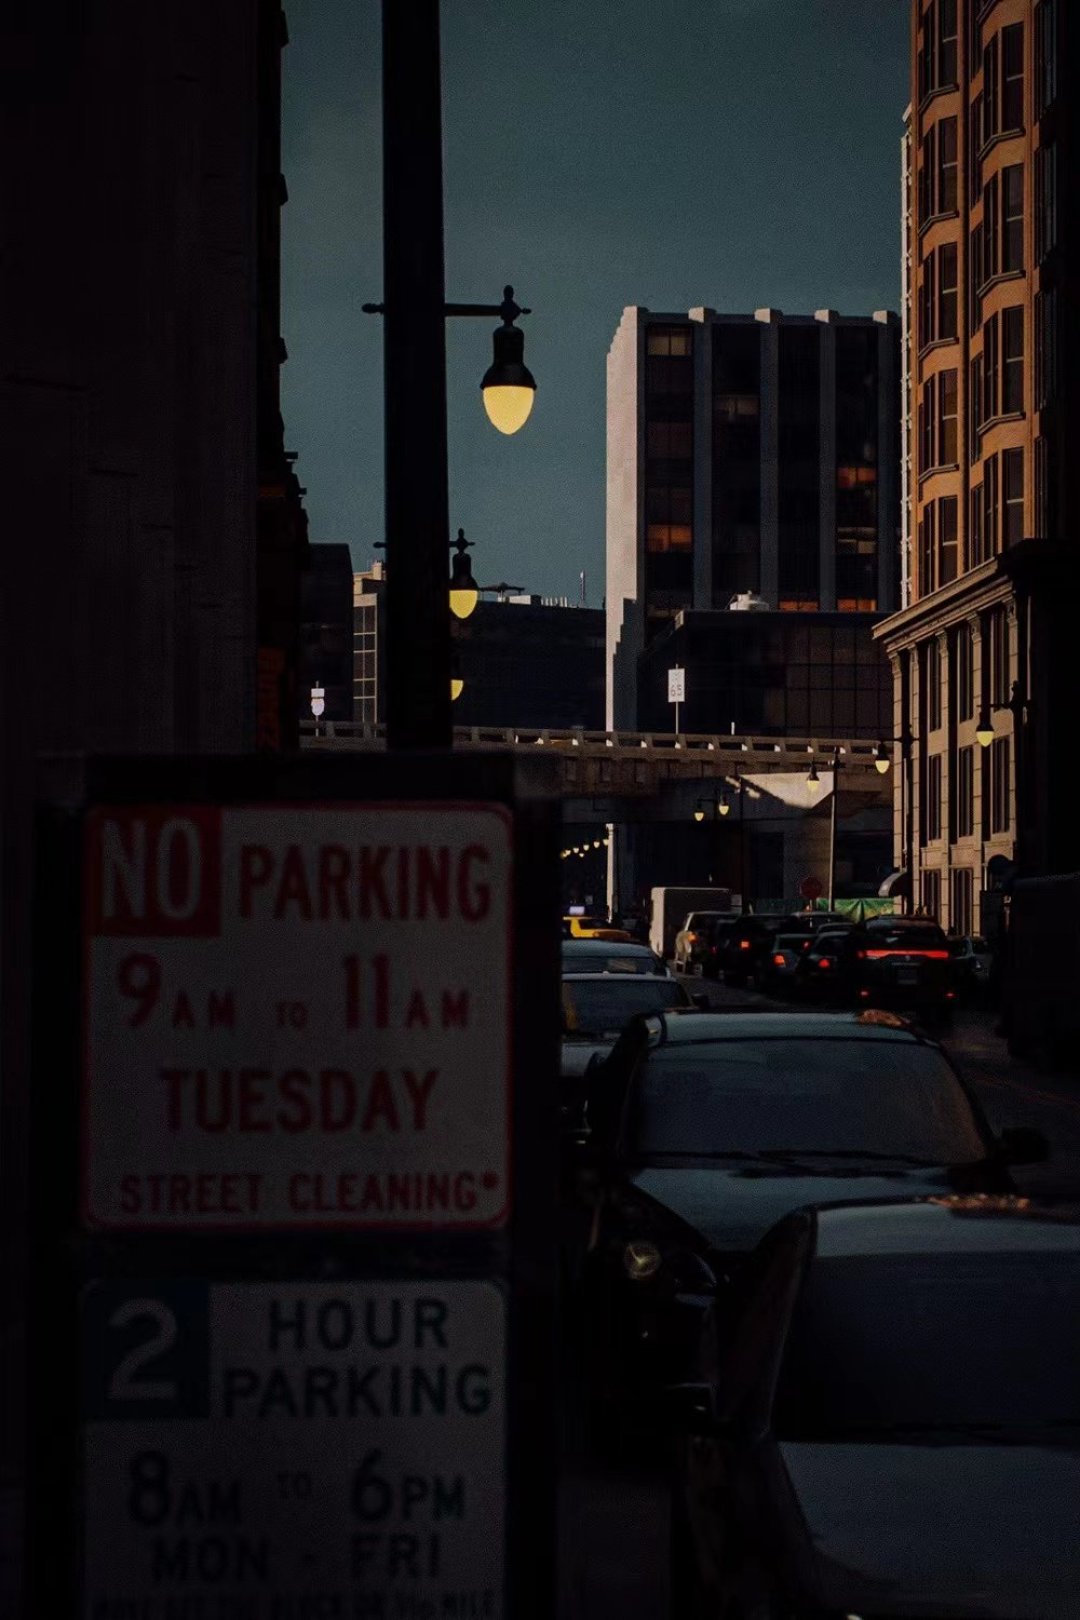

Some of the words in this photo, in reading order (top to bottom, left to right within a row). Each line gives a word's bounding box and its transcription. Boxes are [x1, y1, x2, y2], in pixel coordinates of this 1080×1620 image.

[103, 819, 200, 919] NO
[238, 843, 491, 922] PARKING
[276, 1001, 308, 1031] TO
[159, 1067, 439, 1134] TUESDAY
[120, 1171, 263, 1213] STREET
[108, 1299, 177, 1400] 2
[269, 1299, 449, 1351] HOUR
[224, 1363, 491, 1418] PARKING
[277, 1471, 312, 1500] TO
[151, 1537, 268, 1582] MON
[350, 1533, 438, 1578] FRI
